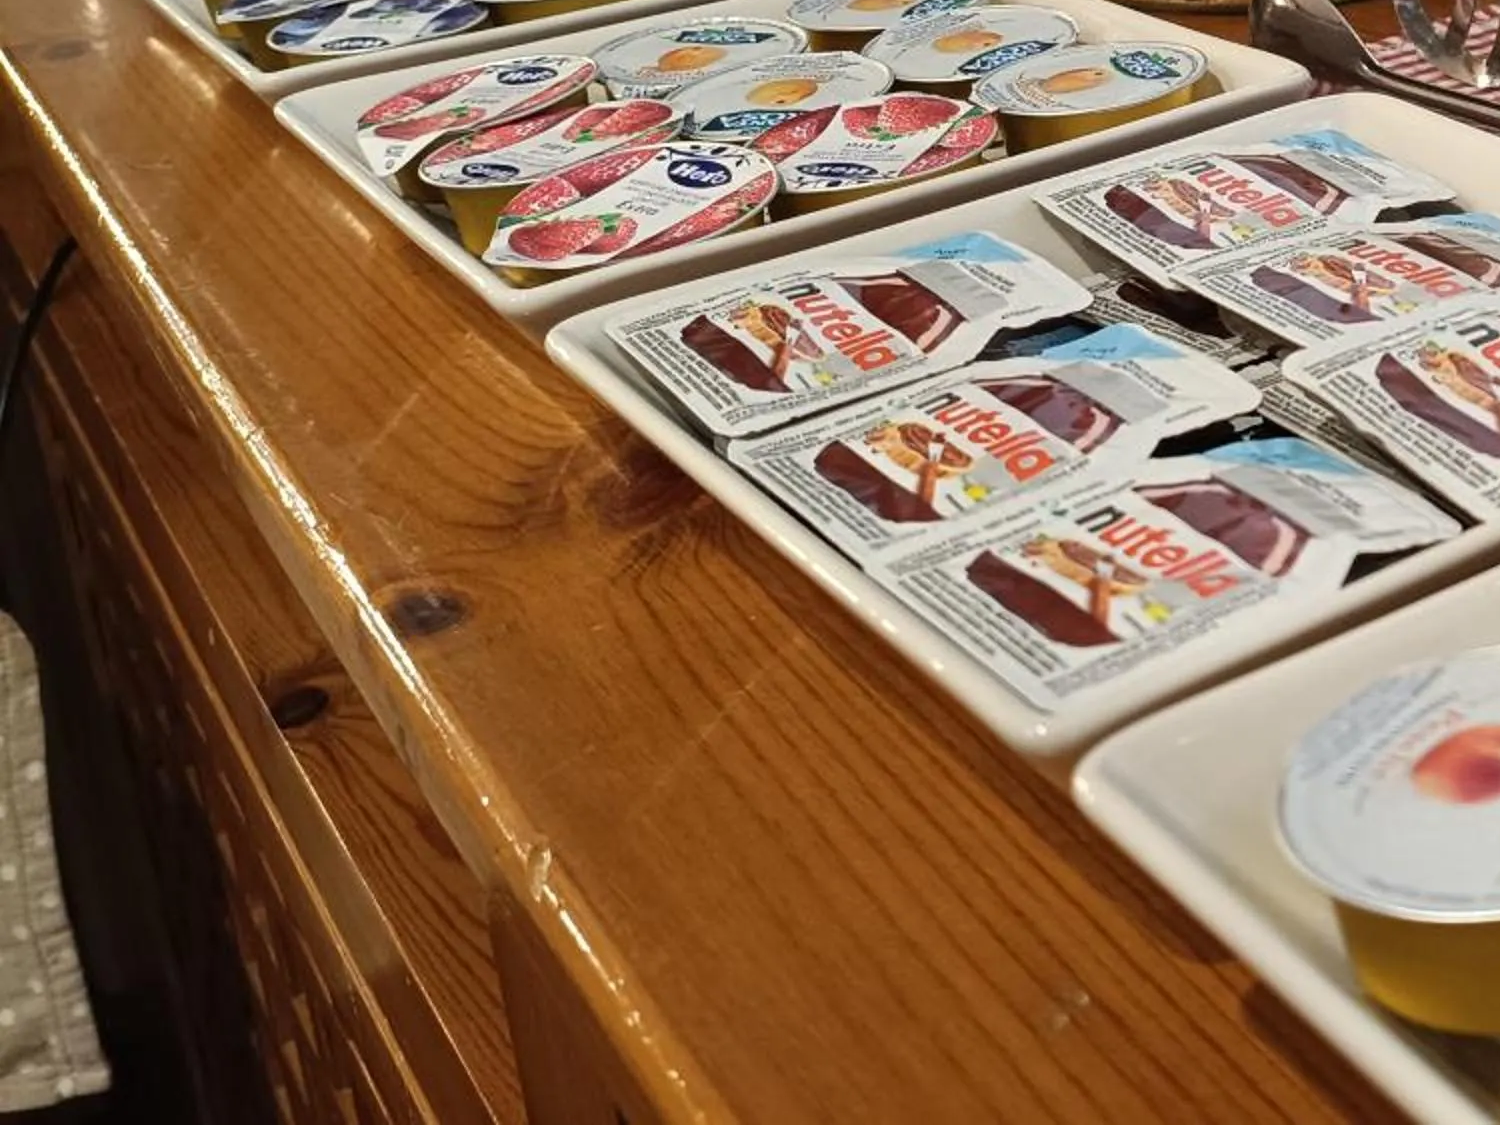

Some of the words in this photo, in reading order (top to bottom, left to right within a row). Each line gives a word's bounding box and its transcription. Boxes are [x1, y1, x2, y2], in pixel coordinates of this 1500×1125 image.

[669, 162, 728, 184] Hero
[1182, 160, 1302, 227] nutella
[1328, 238, 1470, 298] nutella
[778, 282, 897, 370] nutella
[914, 392, 1056, 482] nutella
[1074, 505, 1239, 598] nutella
